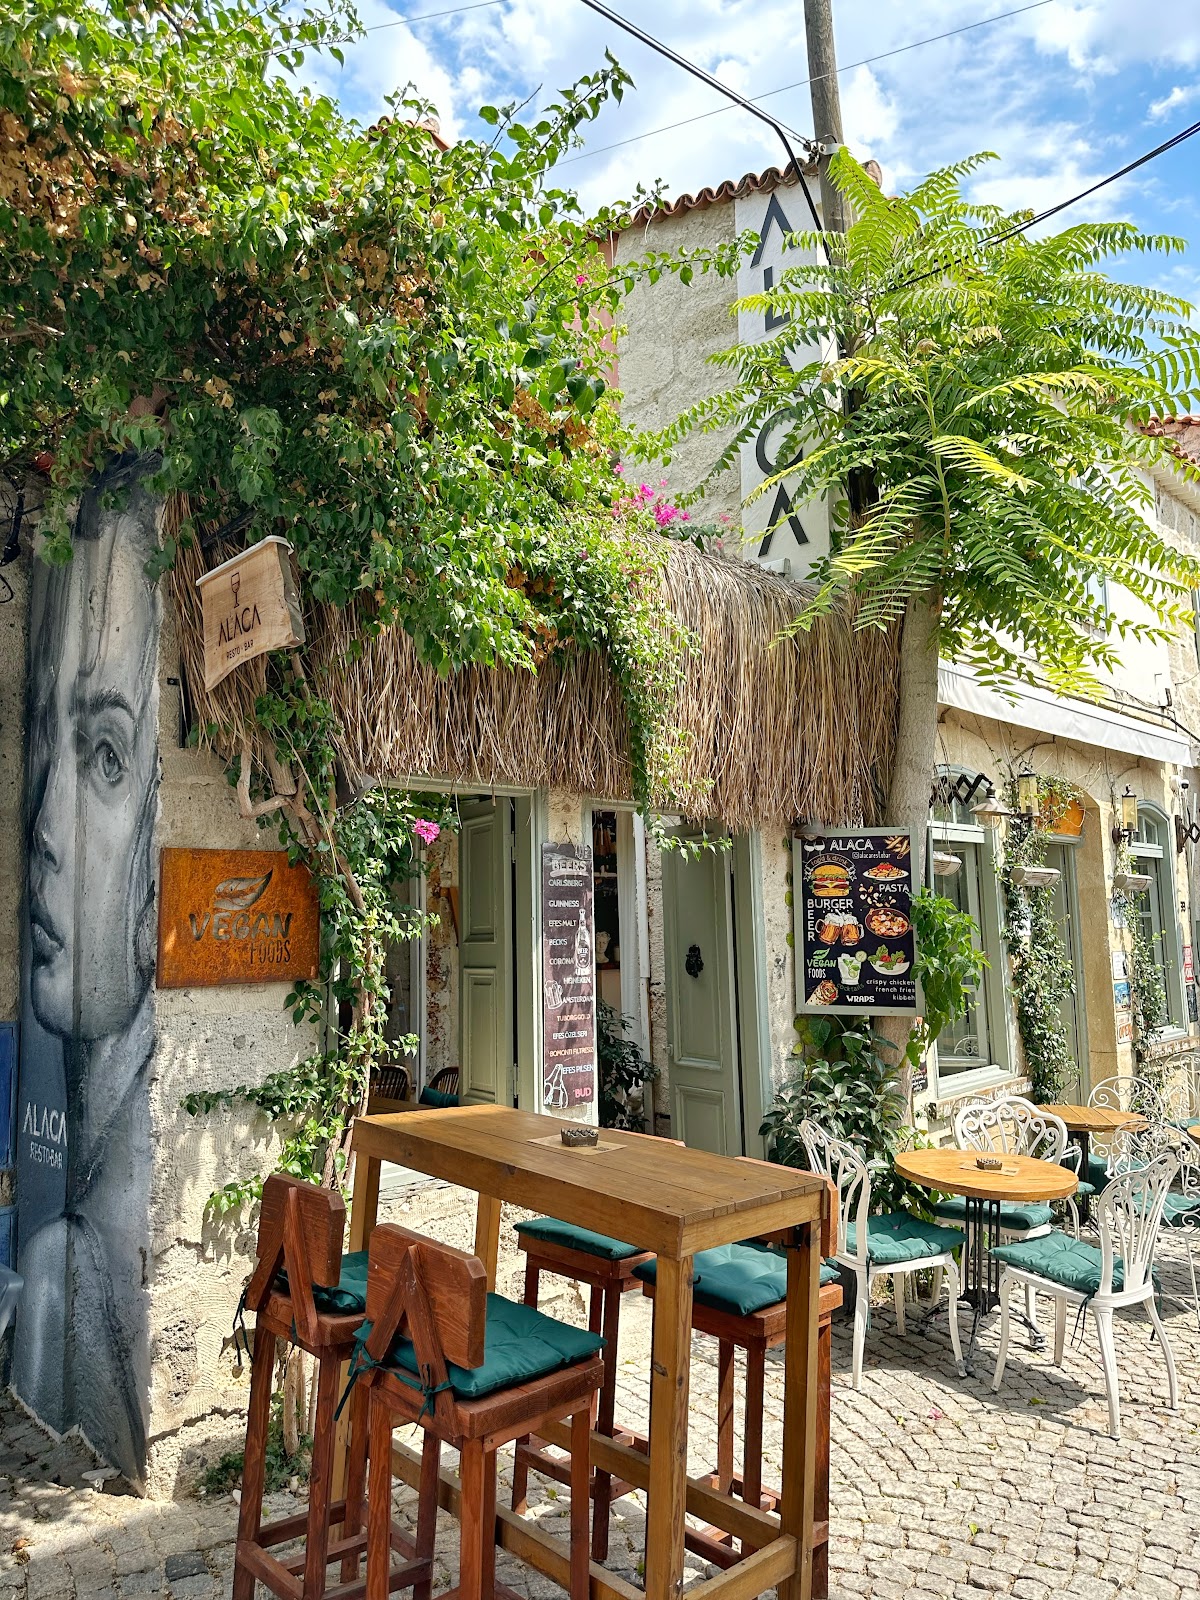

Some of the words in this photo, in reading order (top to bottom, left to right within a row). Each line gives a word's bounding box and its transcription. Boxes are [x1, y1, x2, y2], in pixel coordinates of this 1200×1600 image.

[750, 192, 812, 558] ALCA
[219, 604, 262, 647] ALACA
[829, 839, 874, 851] ALACA
[551, 860, 587, 871] BEERS
[548, 879, 583, 887] CARLSBERG
[879, 884, 909, 893] PASTA
[548, 900, 580, 908] GUINNESS
[807, 898, 854, 909] BURGER
[189, 911, 293, 941] VEGAN
[250, 939, 291, 964] FOODS
[807, 959, 837, 968] VEGAN
[808, 968, 827, 979] FOODS
[846, 994, 876, 1003] WRAPS
[552, 1032, 565, 1040] EFES
[562, 1066, 576, 1075] EFES
[574, 1087, 592, 1099] BUD
[22, 1101, 68, 1147] ALACA
